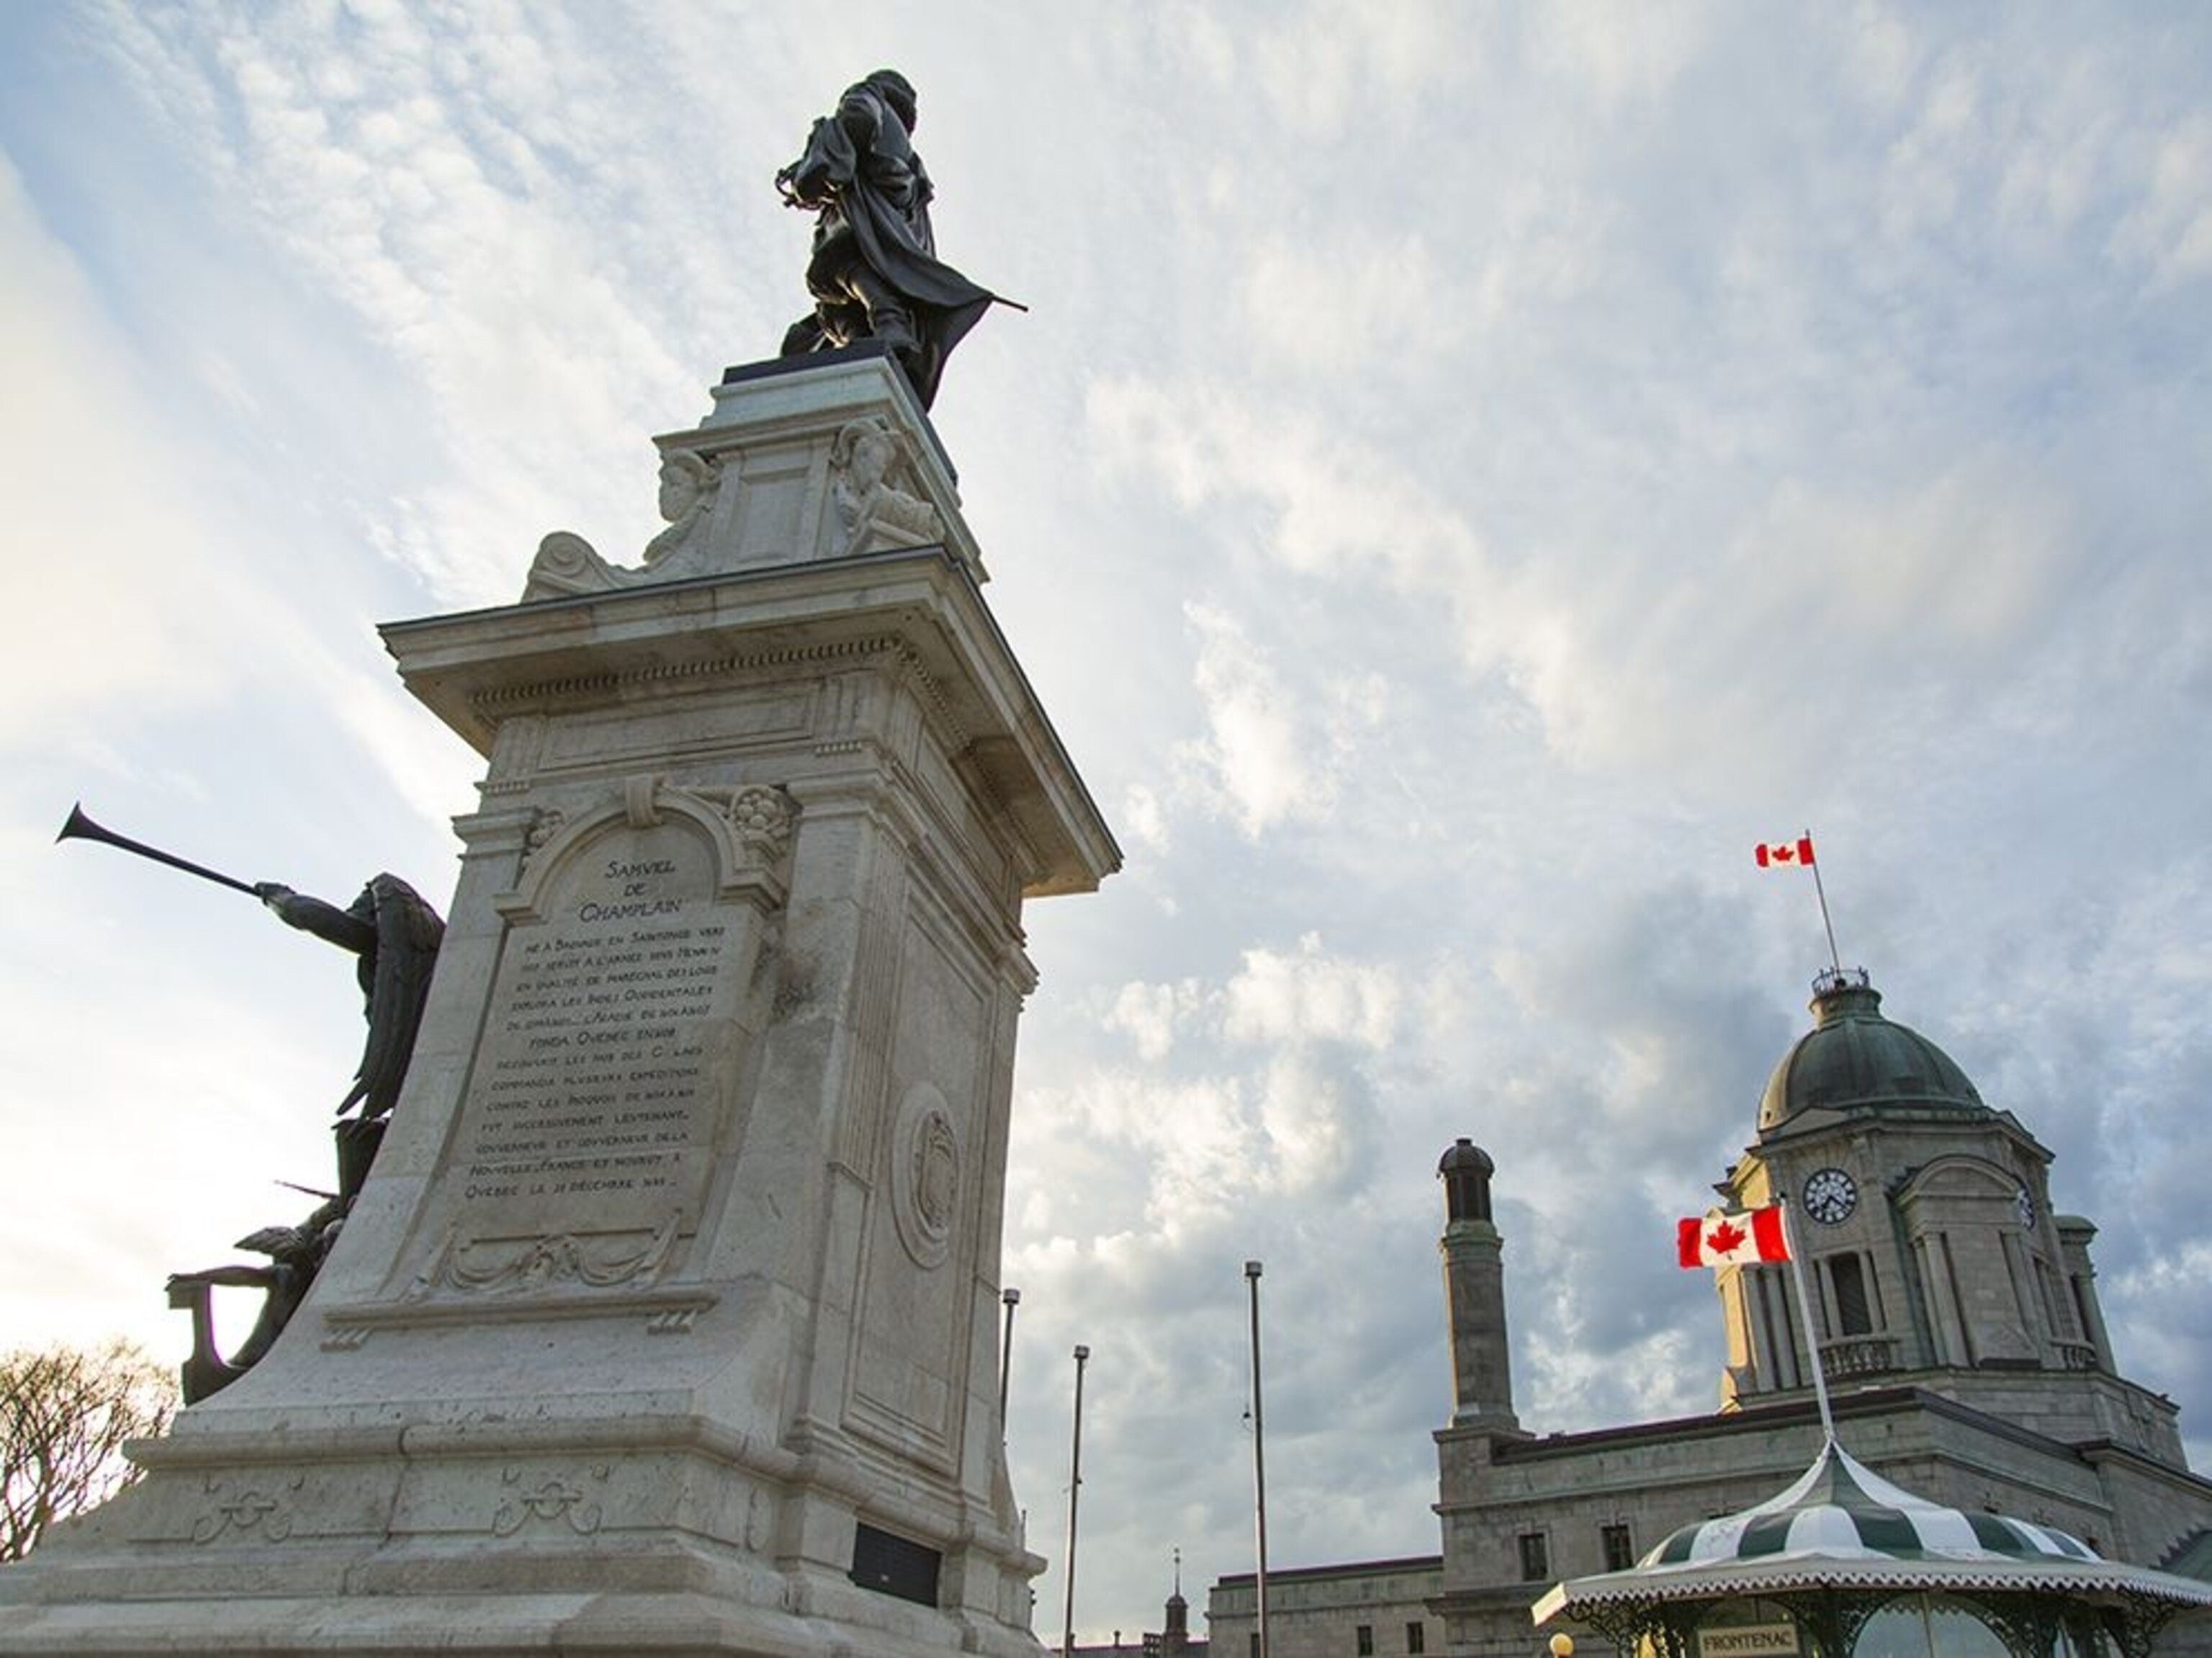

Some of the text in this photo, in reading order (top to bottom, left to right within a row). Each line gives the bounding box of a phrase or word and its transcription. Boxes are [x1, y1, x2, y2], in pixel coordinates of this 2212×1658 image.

[623, 882, 648, 897] DE
[580, 897, 683, 923] CHAMPLAIN
[1703, 1630, 1793, 1651] FRONTENAC
